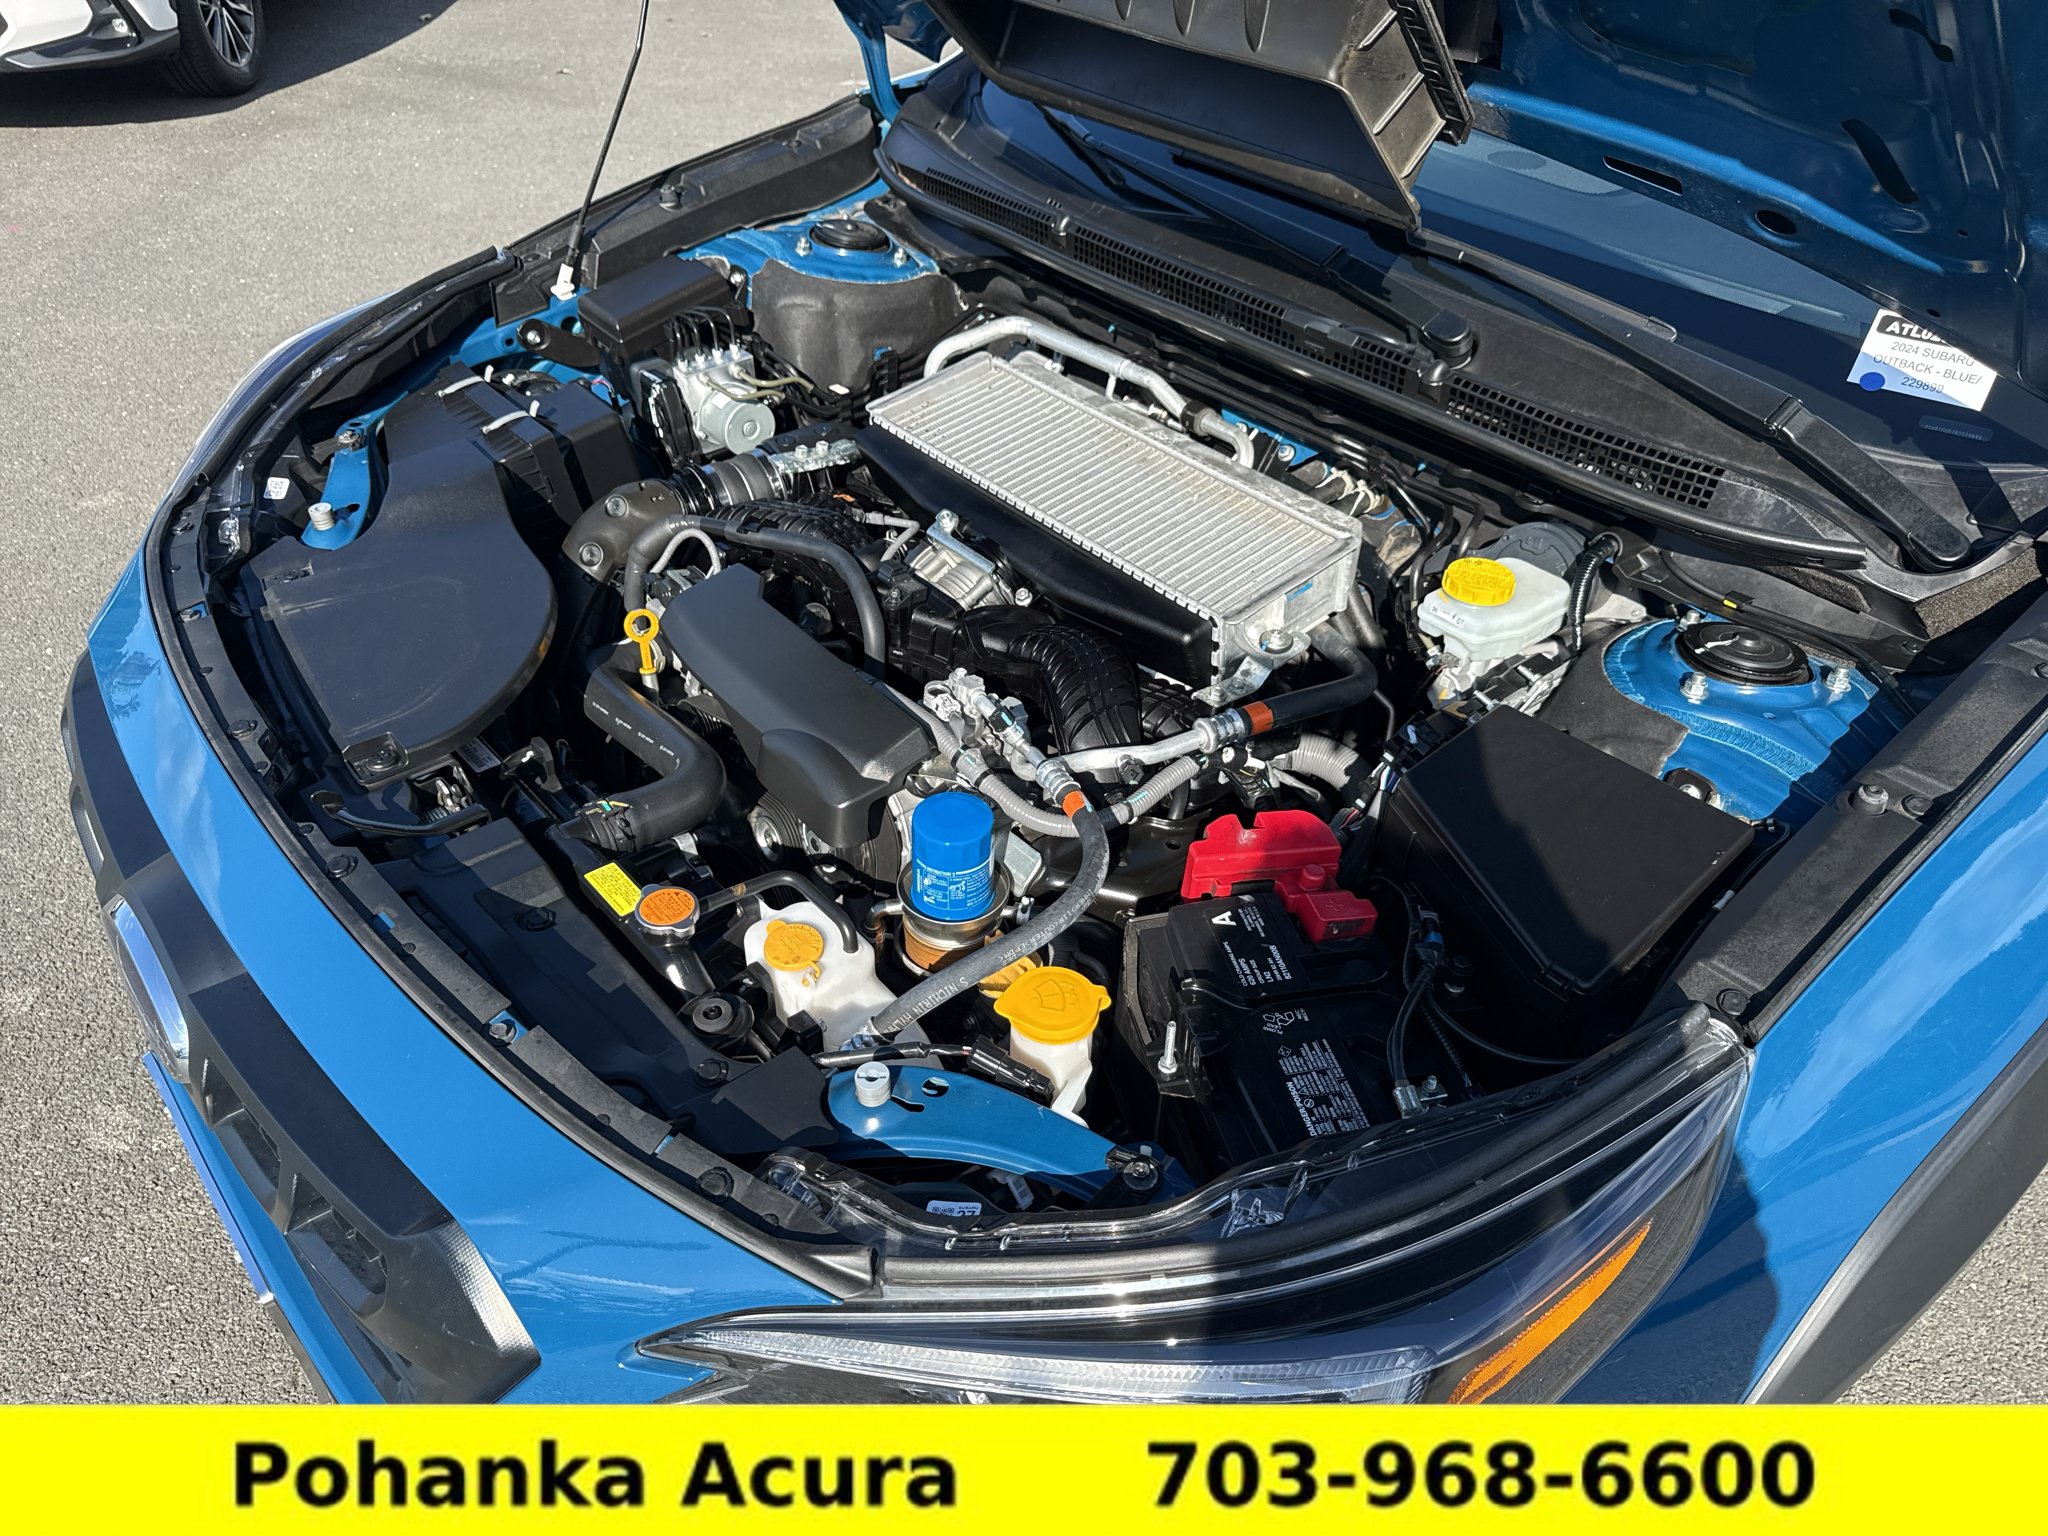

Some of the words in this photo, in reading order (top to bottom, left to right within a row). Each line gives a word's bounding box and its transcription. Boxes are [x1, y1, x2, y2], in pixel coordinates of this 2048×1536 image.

[1890, 341, 1920, 355] 2024
[1922, 347, 1975, 367] SUBARU
[1873, 354, 1935, 375] OUTBACK
[1943, 368, 1983, 385] BLUE/
[1211, 910, 1237, 926] A
[1238, 957, 1252, 975] AMPS
